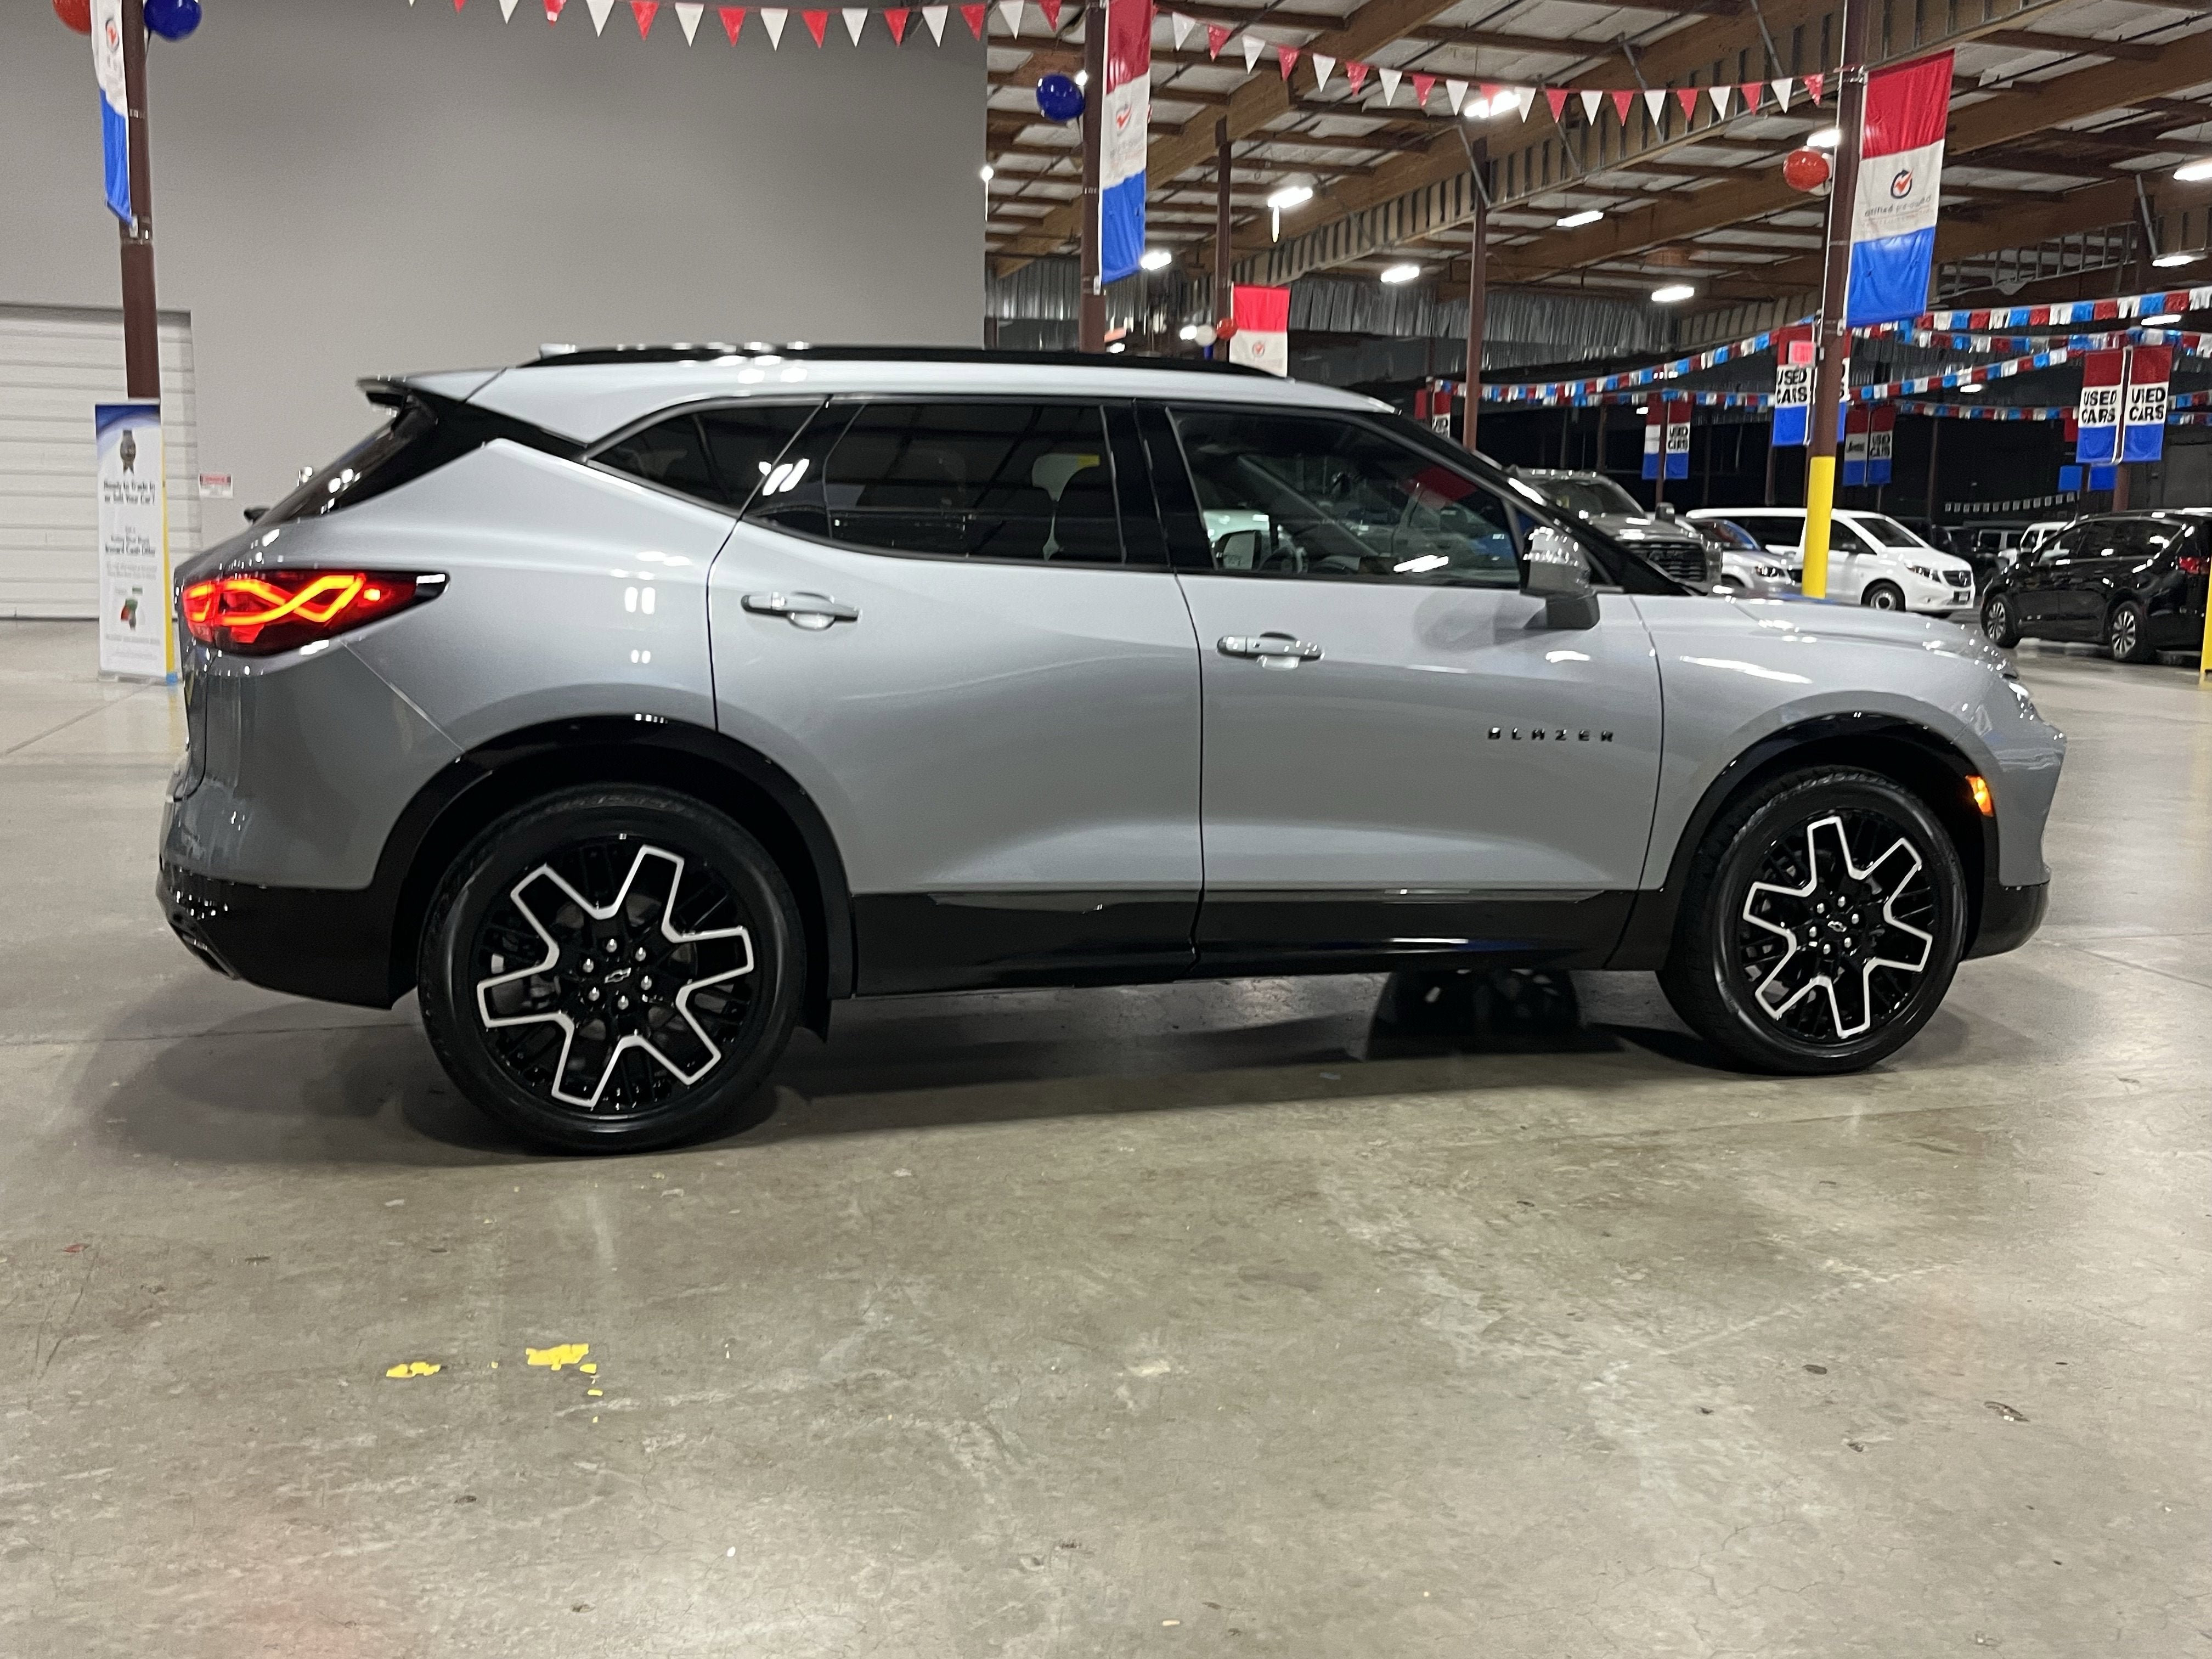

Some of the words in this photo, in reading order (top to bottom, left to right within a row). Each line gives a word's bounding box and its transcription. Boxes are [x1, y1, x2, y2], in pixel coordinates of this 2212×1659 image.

[2084, 390, 2117, 405] USED
[2081, 408, 2116, 424] CARS
[2129, 404, 2164, 421] CARS
[1487, 727, 1613, 742] BLAZER
